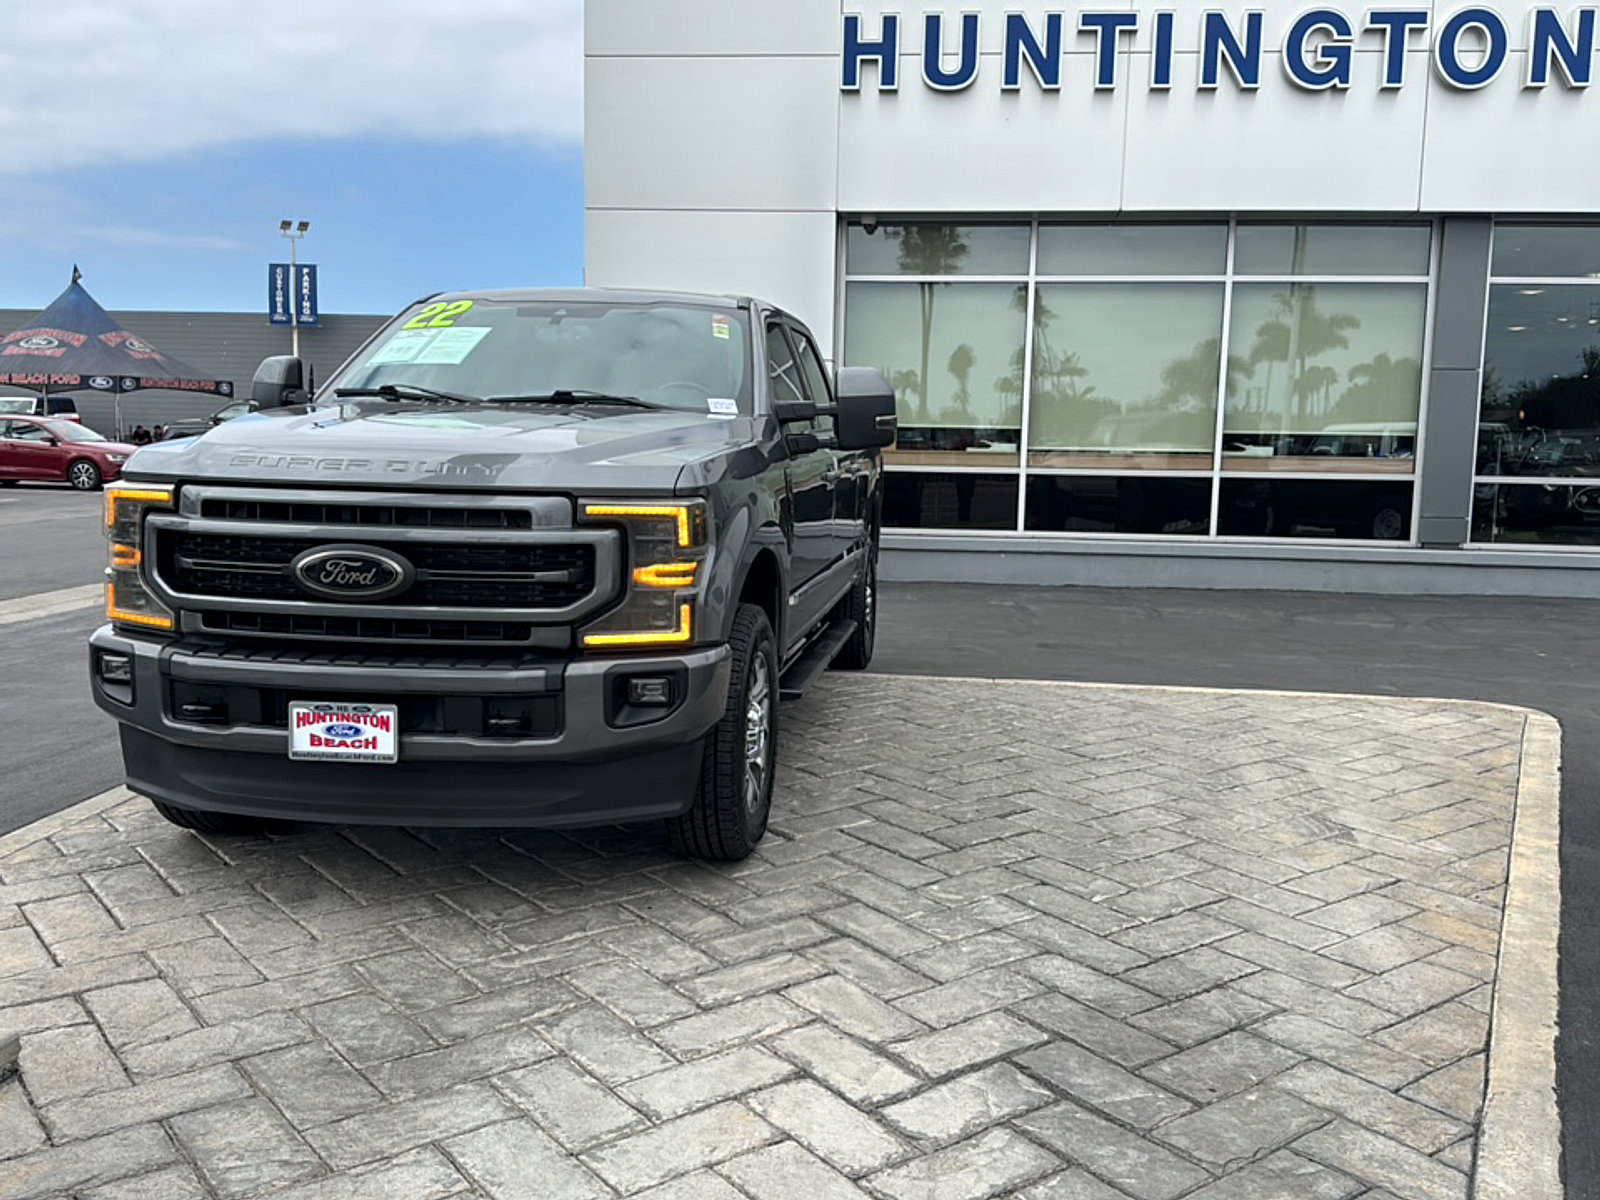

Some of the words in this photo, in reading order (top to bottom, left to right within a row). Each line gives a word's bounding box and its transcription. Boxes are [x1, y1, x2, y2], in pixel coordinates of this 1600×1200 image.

[840, 7, 1597, 93] HUNTINGTON
[302, 267, 311, 315] PARKING
[402, 299, 474, 331] 22
[229, 455, 372, 472] SUPER
[386, 459, 504, 476] DUTY
[320, 560, 377, 585] Ford
[296, 711, 391, 733] HUNTINGTON
[310, 733, 378, 750] BEACH
